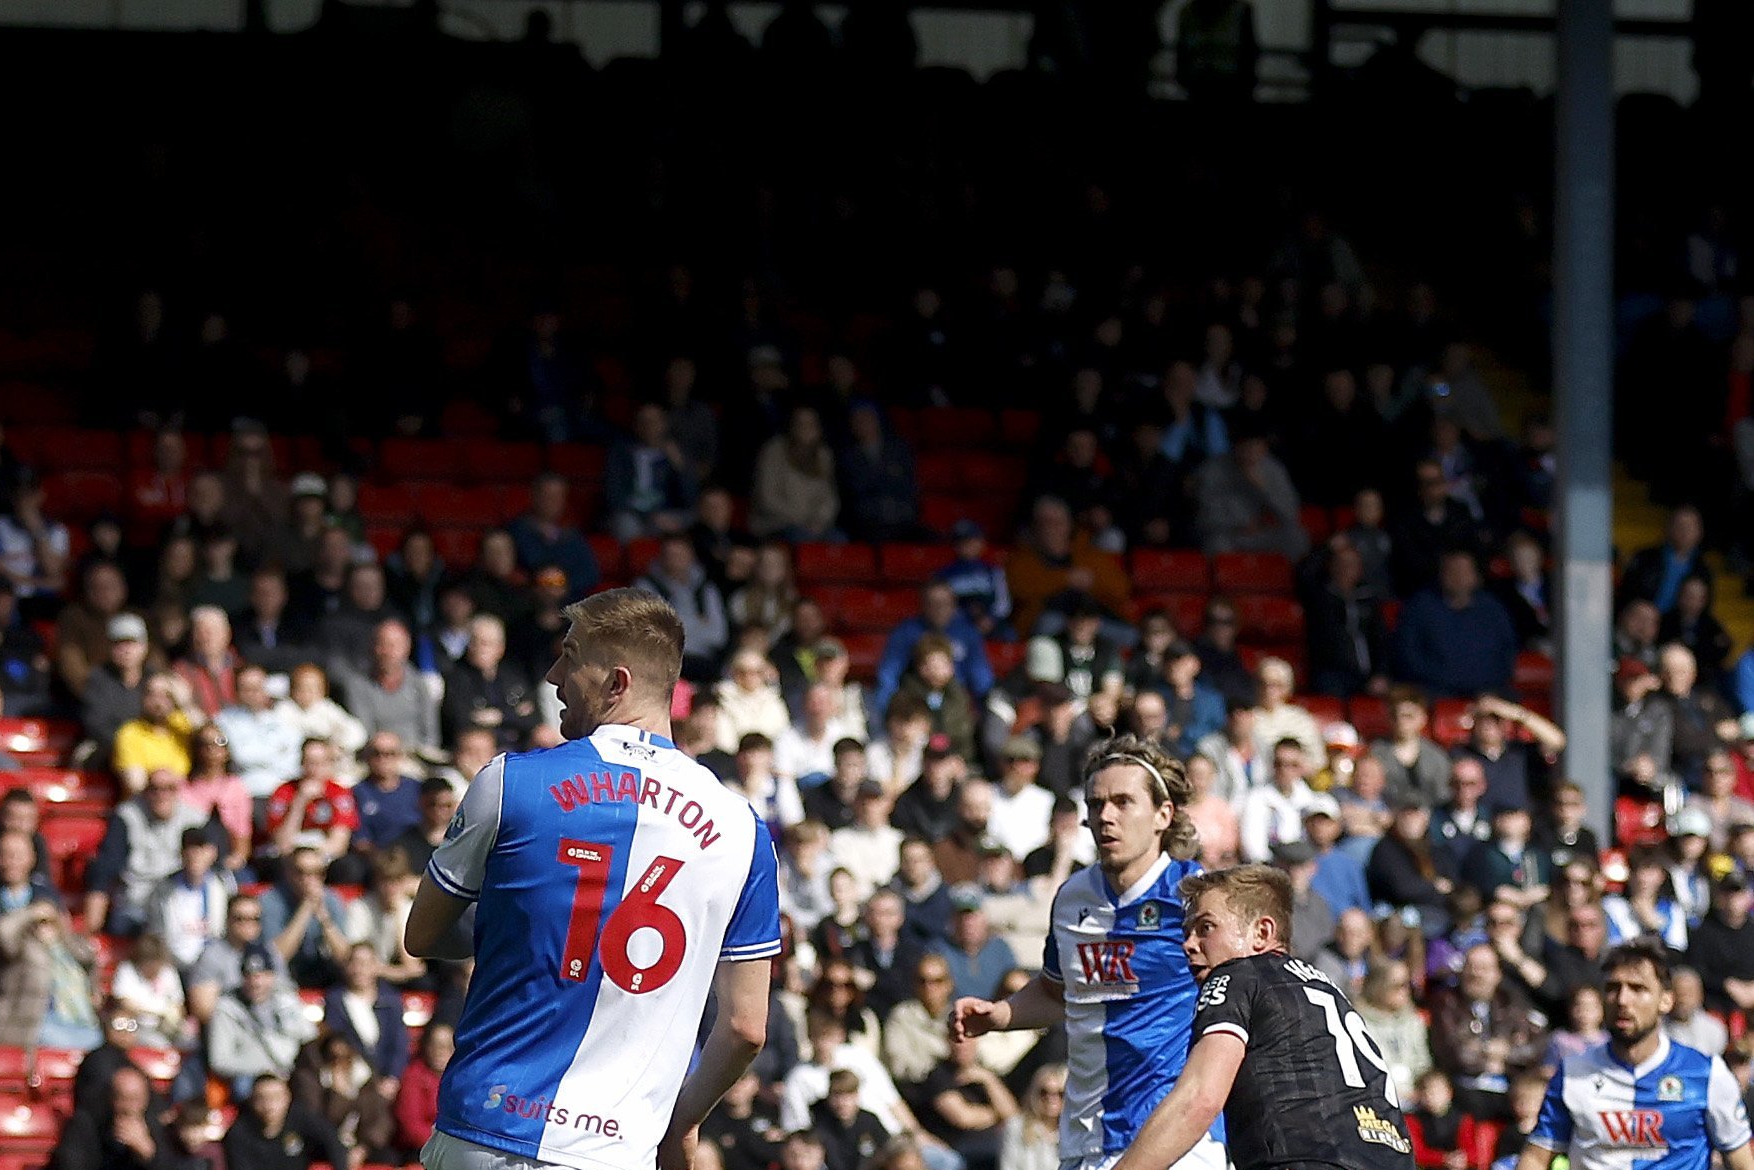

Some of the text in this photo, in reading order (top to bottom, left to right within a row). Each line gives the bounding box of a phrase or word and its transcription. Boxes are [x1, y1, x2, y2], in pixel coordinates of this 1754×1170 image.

[548, 771, 722, 851] WHARTON
[555, 837, 687, 995] 16
[1077, 940, 1140, 985] WR
[503, 1094, 623, 1140] suits me.
[1597, 1109, 1668, 1148] WR
